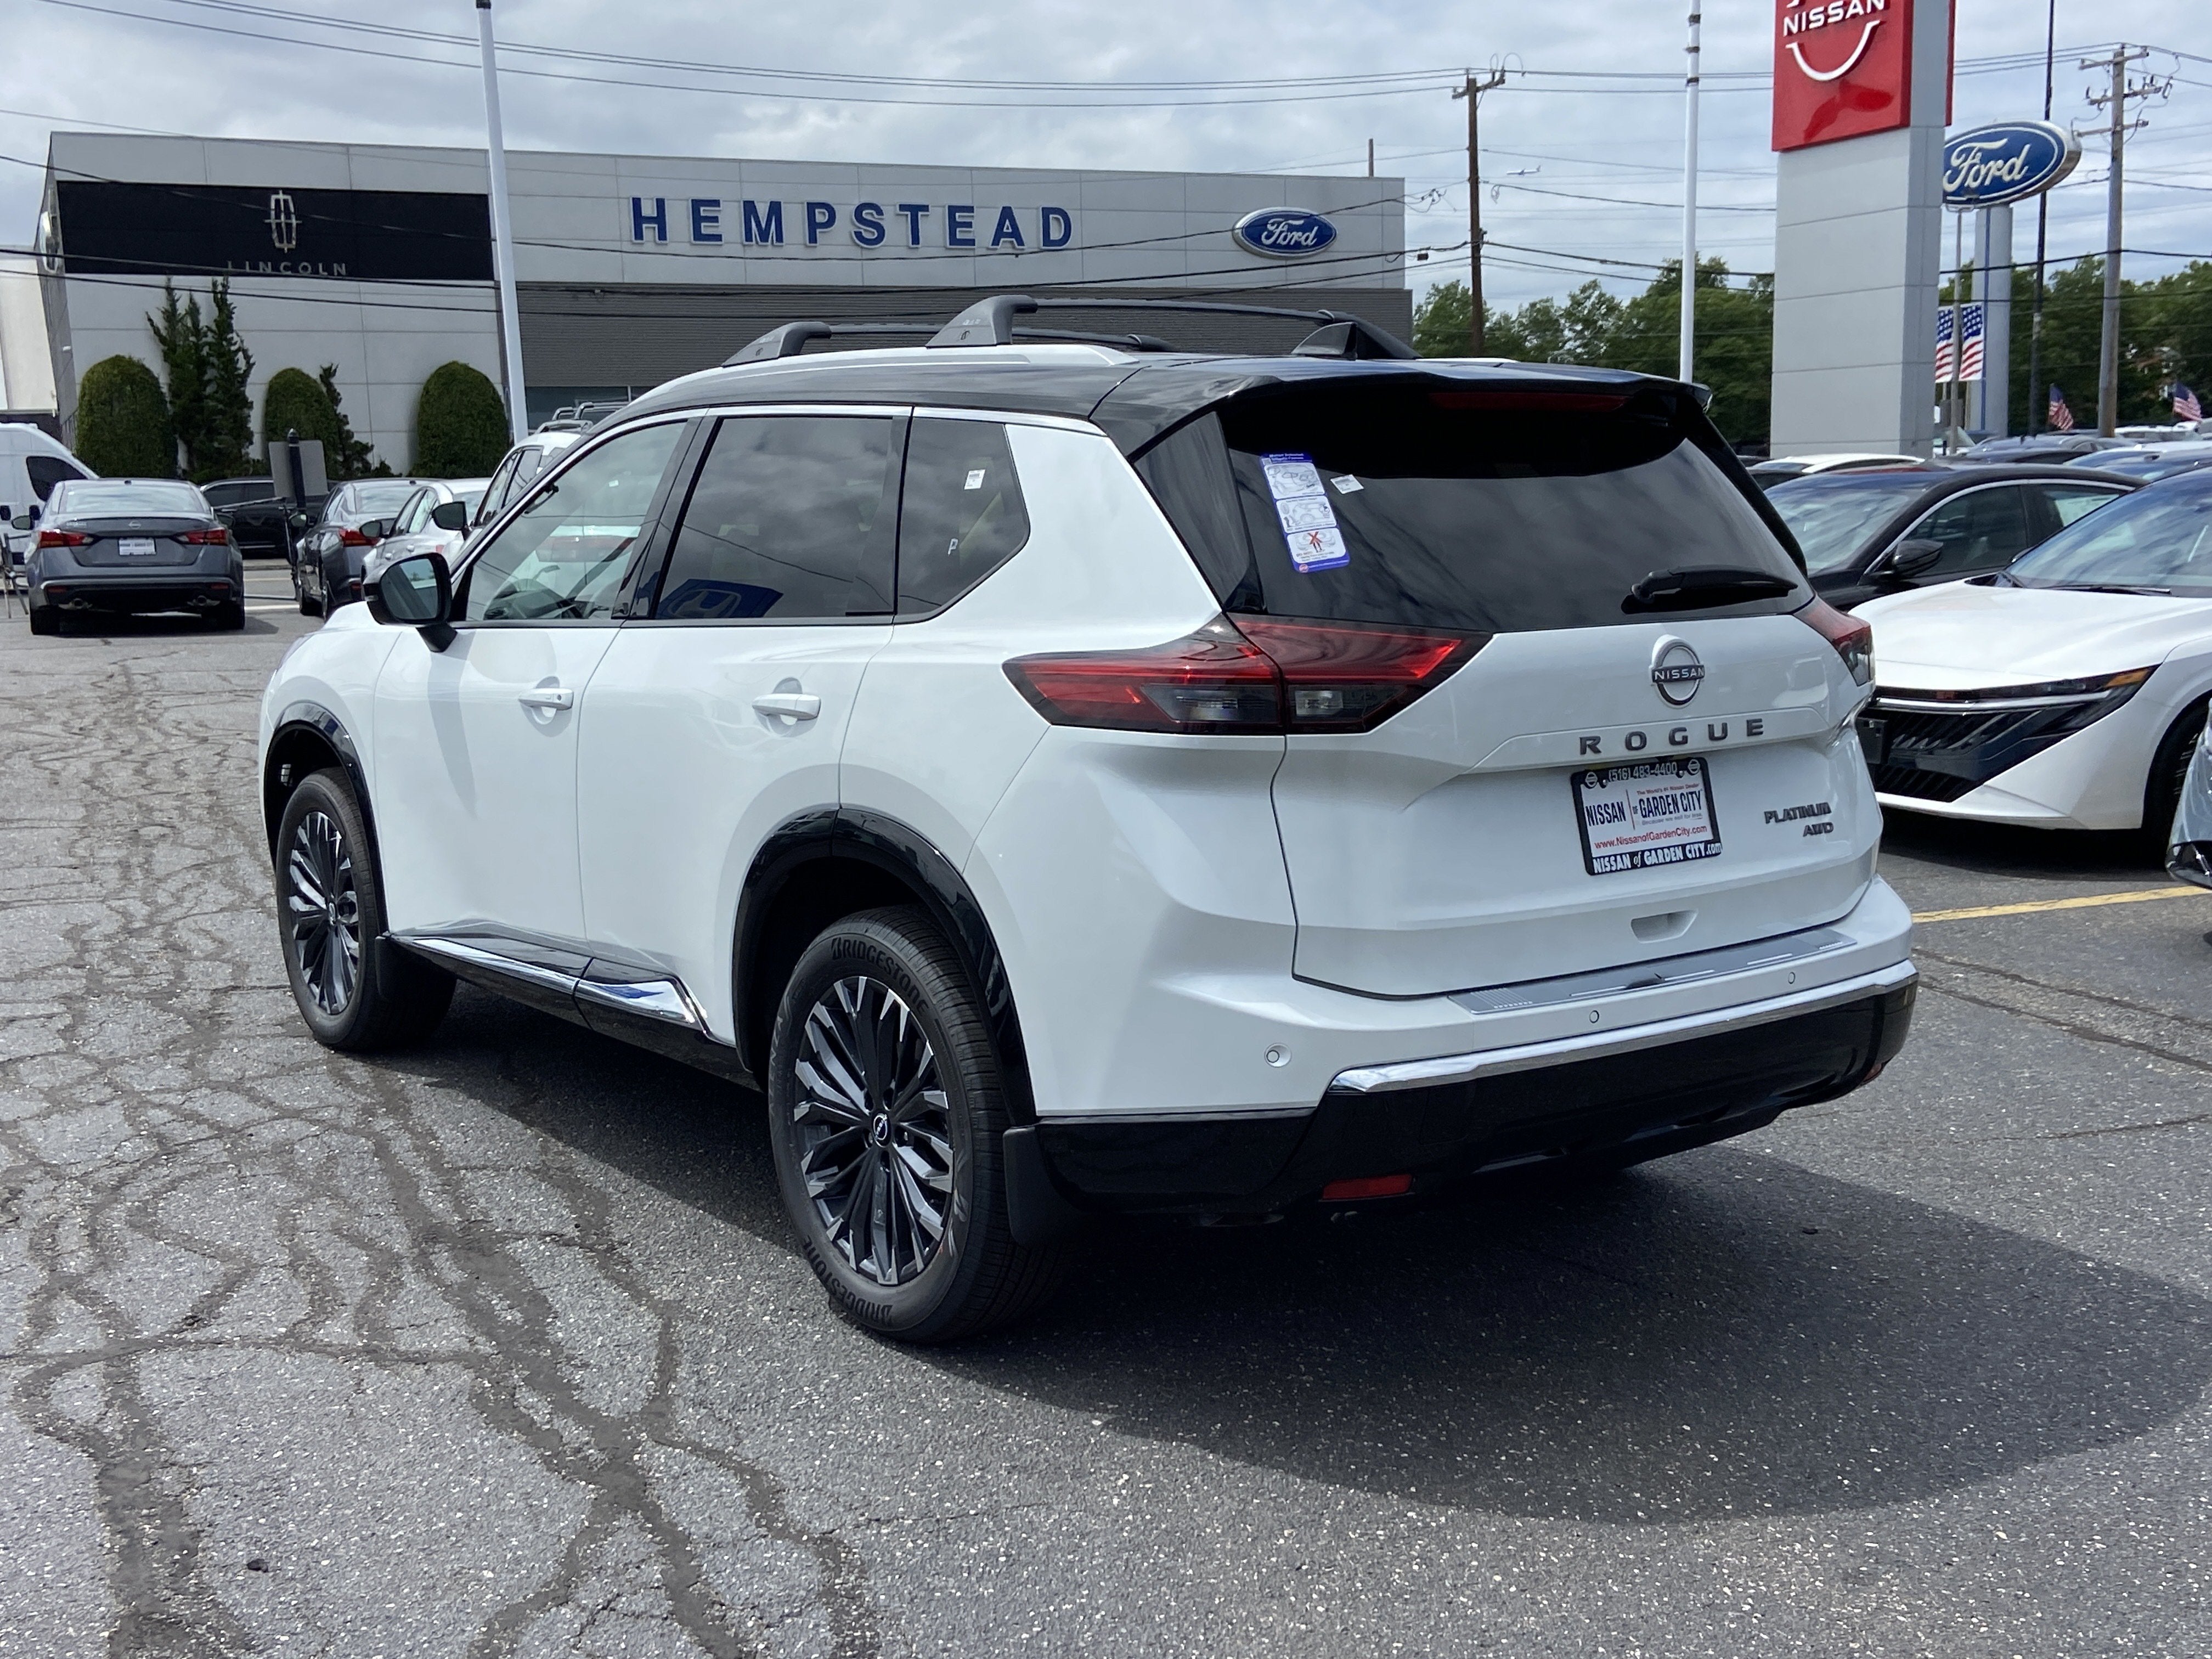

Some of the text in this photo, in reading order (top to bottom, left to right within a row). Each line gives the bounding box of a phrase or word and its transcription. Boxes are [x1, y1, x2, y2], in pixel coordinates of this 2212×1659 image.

[1783, 0, 1885, 37] NISSAN
[1943, 138, 2031, 192] Ford
[630, 195, 1073, 251] HEMPSTEAD
[1261, 218, 1319, 246] Ford
[227, 261, 347, 276] LINCOLN
[1655, 667, 1705, 680] NISSAN
[1579, 718, 1764, 755] ROGUE
[1609, 762, 1678, 783] (516) 483-4400
[1585, 802, 1627, 827] NISSAN
[1639, 793, 1680, 819] GARDEN
[1680, 790, 1702, 812] CITY
[1763, 802, 1832, 824] PLATINUM
[1594, 825, 1707, 849] www.NissanofGardenCity.com
[1803, 822, 1834, 837] AWD
[1593, 853, 1632, 873] NISSAN
[1633, 851, 1641, 867] of
[1644, 846, 1684, 865] GARDEN
